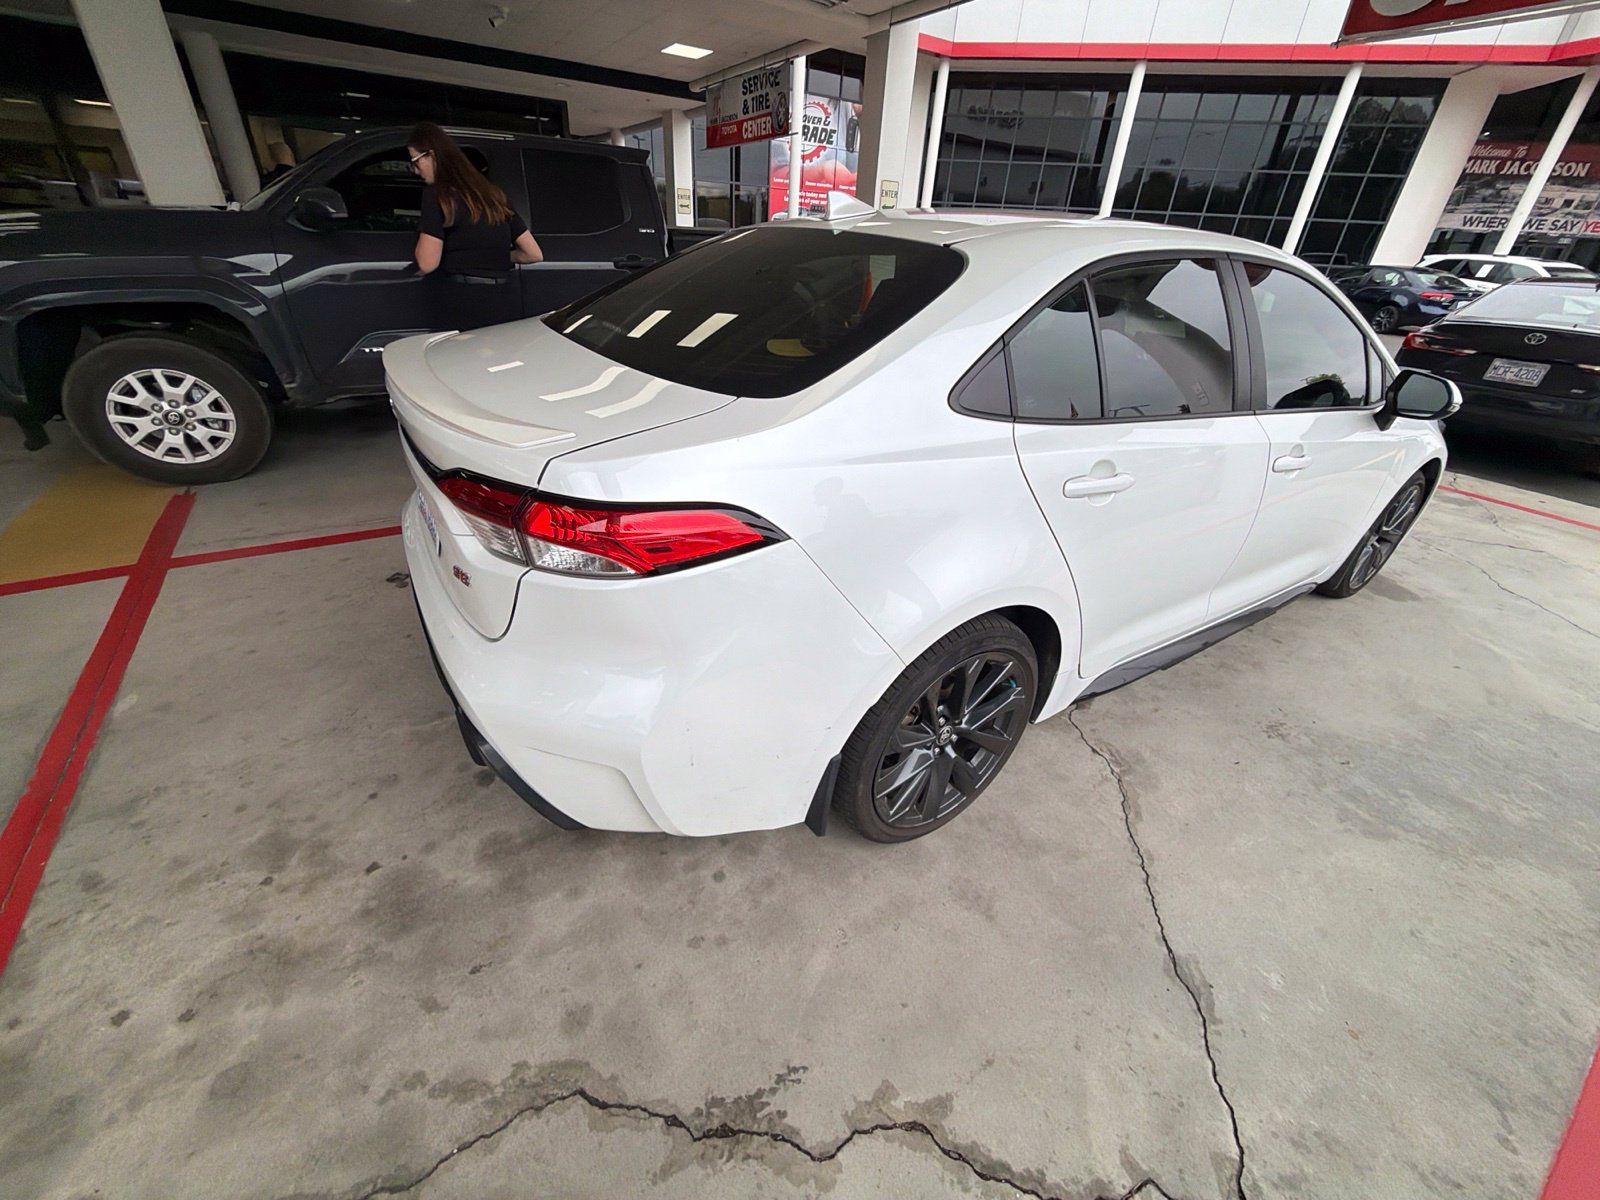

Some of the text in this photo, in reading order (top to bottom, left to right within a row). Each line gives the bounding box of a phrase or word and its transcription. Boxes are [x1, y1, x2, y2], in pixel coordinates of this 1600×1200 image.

[742, 70, 781, 95] SERVICE
[742, 92, 771, 115] & TIRE
[742, 116, 772, 139] CENTER
[802, 114, 822, 125] OVER
[801, 124, 837, 145] RADE
[1462, 215, 1509, 228] WHER
[1548, 219, 1579, 232] SAY
[1582, 220, 1600, 232] YE
